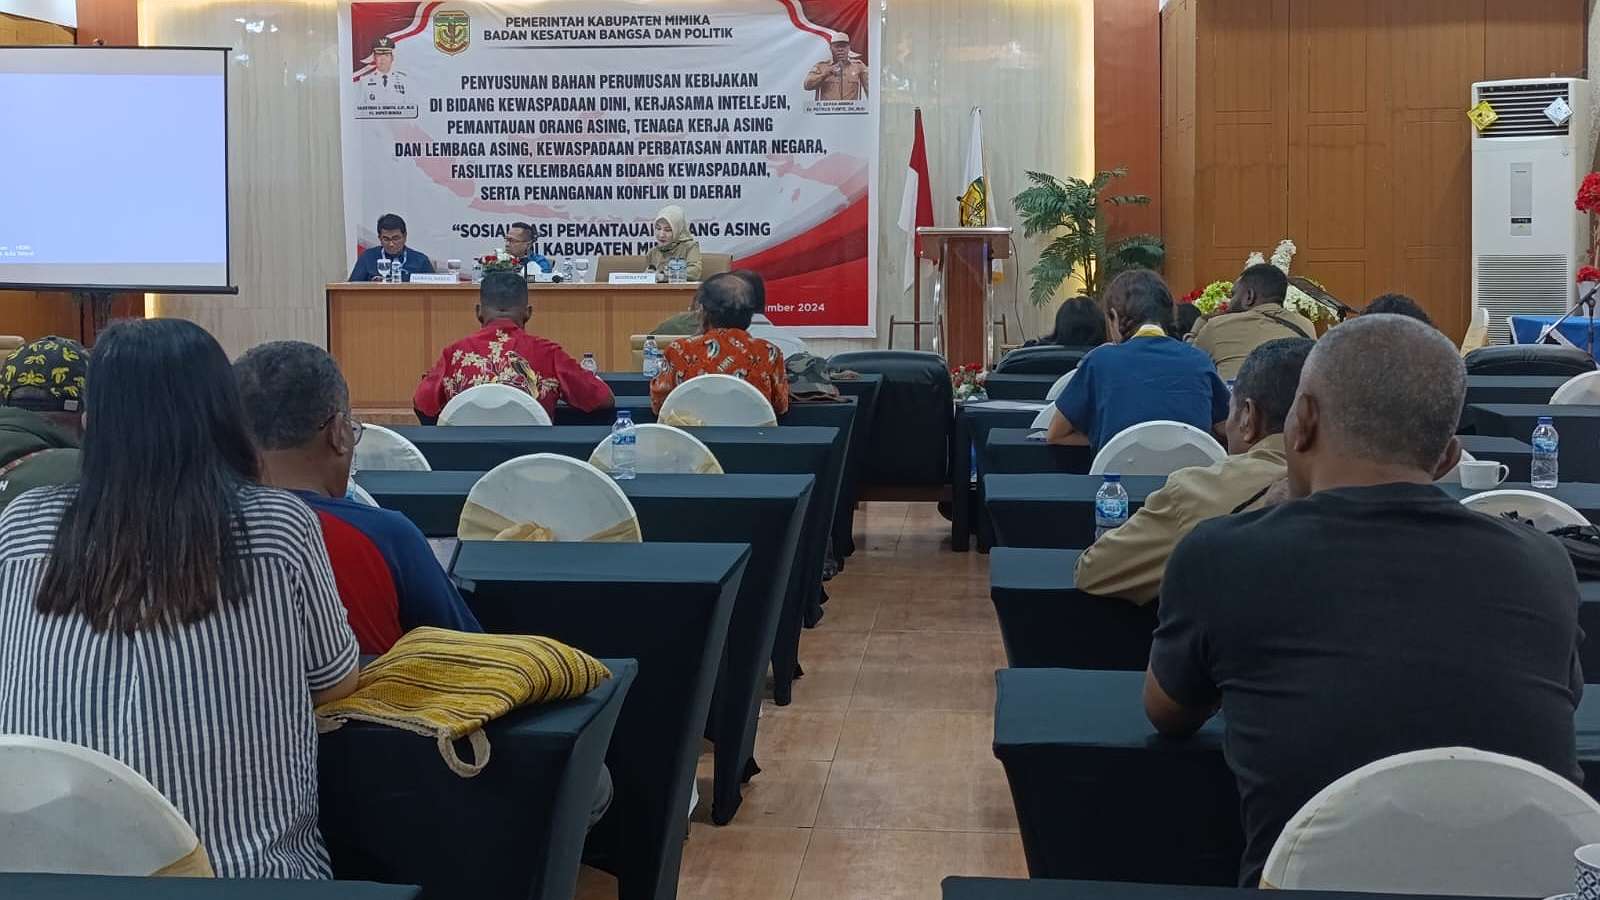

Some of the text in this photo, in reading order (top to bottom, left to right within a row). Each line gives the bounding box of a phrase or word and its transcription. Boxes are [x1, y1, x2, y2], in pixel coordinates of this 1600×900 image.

[506, 15, 710, 28] PEMERINTAH KABUPATEN MIMIKA
[484, 28, 732, 41] BADAN KESATUAN BANGSA DAN POLITIK
[462, 73, 757, 90] PENYUSUNAN BAHAN PERUMUSAN KEBIJAKAN
[430, 95, 790, 113] DI BIDANG KEWASPADAAN DINI, KERJASAMA INTELEJEN,
[448, 118, 773, 135] PEMANTAUAN ORANG ASING, TENAGA KERJA ASING
[396, 140, 826, 158] DAN LEMBAGA ASING, KEWASPADAAN PERBATASAN ANTAR NEGARA,
[452, 163, 770, 179] FASILITAS KELEMBAGAAN BIDANG KEWASPADAAN,
[481, 185, 740, 201] SERTA PENANGANAN KONFLIK DI DAERAH
[724, 222, 771, 236] ASING
[543, 241, 632, 256] KABUPATEN
[798, 302, 825, 312] 2024
